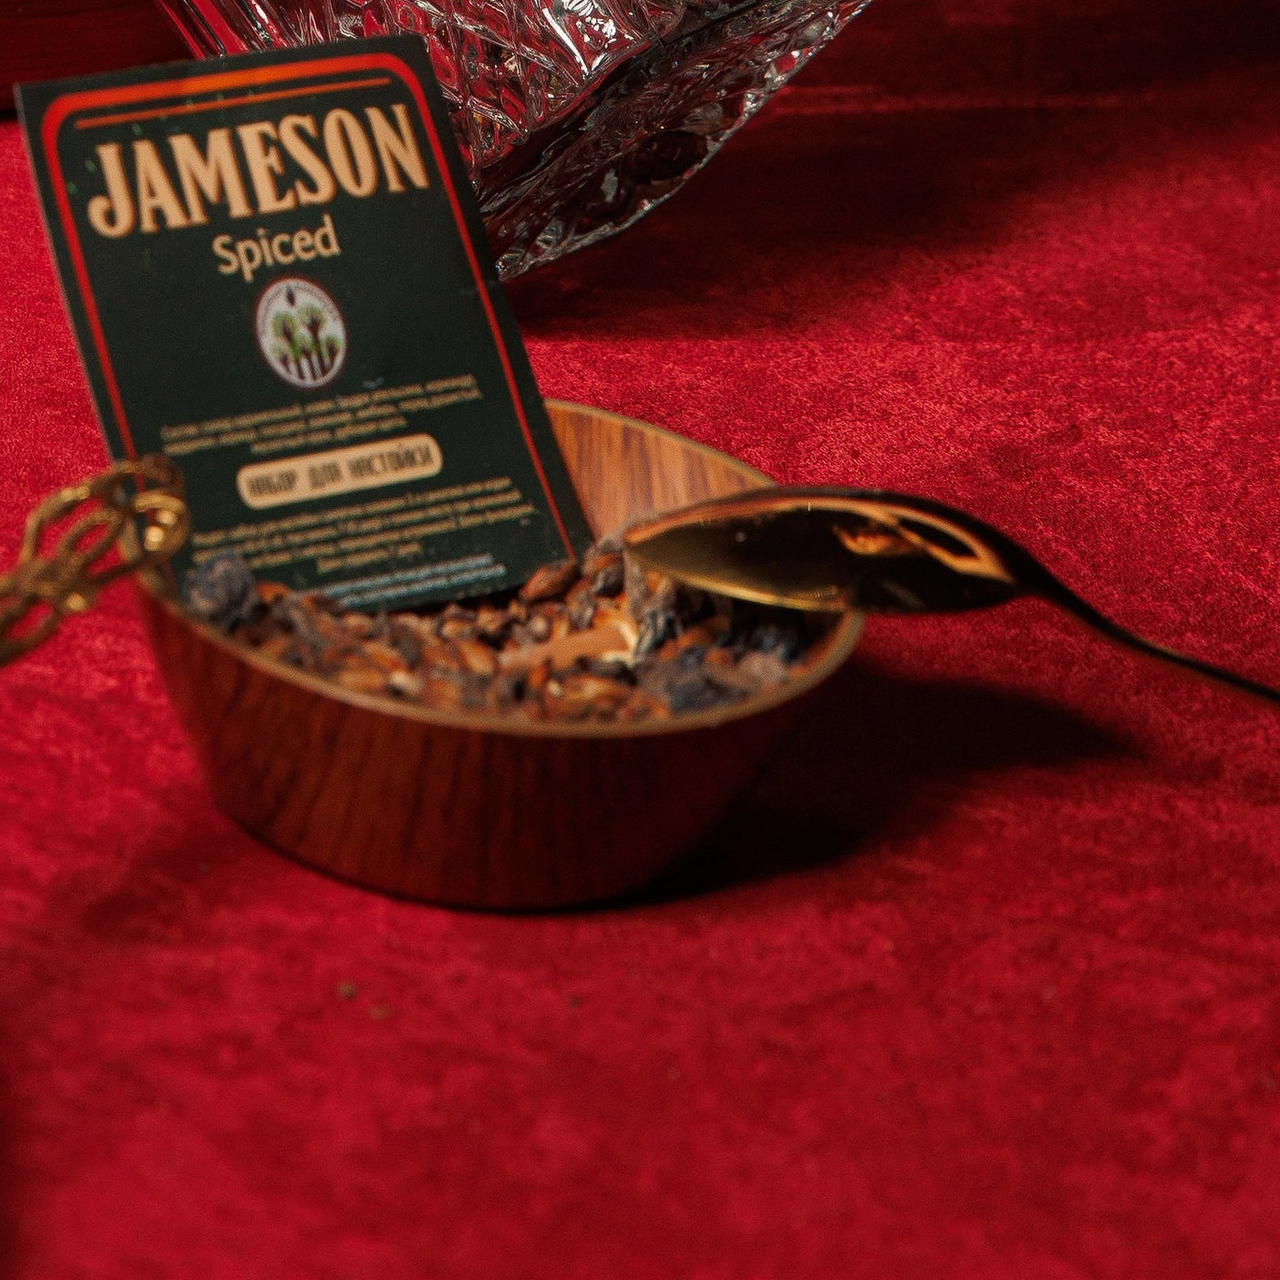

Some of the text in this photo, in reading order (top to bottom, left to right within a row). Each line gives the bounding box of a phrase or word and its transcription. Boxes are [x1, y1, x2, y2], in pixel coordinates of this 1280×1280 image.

[86, 102, 430, 239] JAMESON
[212, 215, 342, 284] Spiced
[248, 443, 433, 497] НАБОР ДЛЯ НАСТОЙКИ
